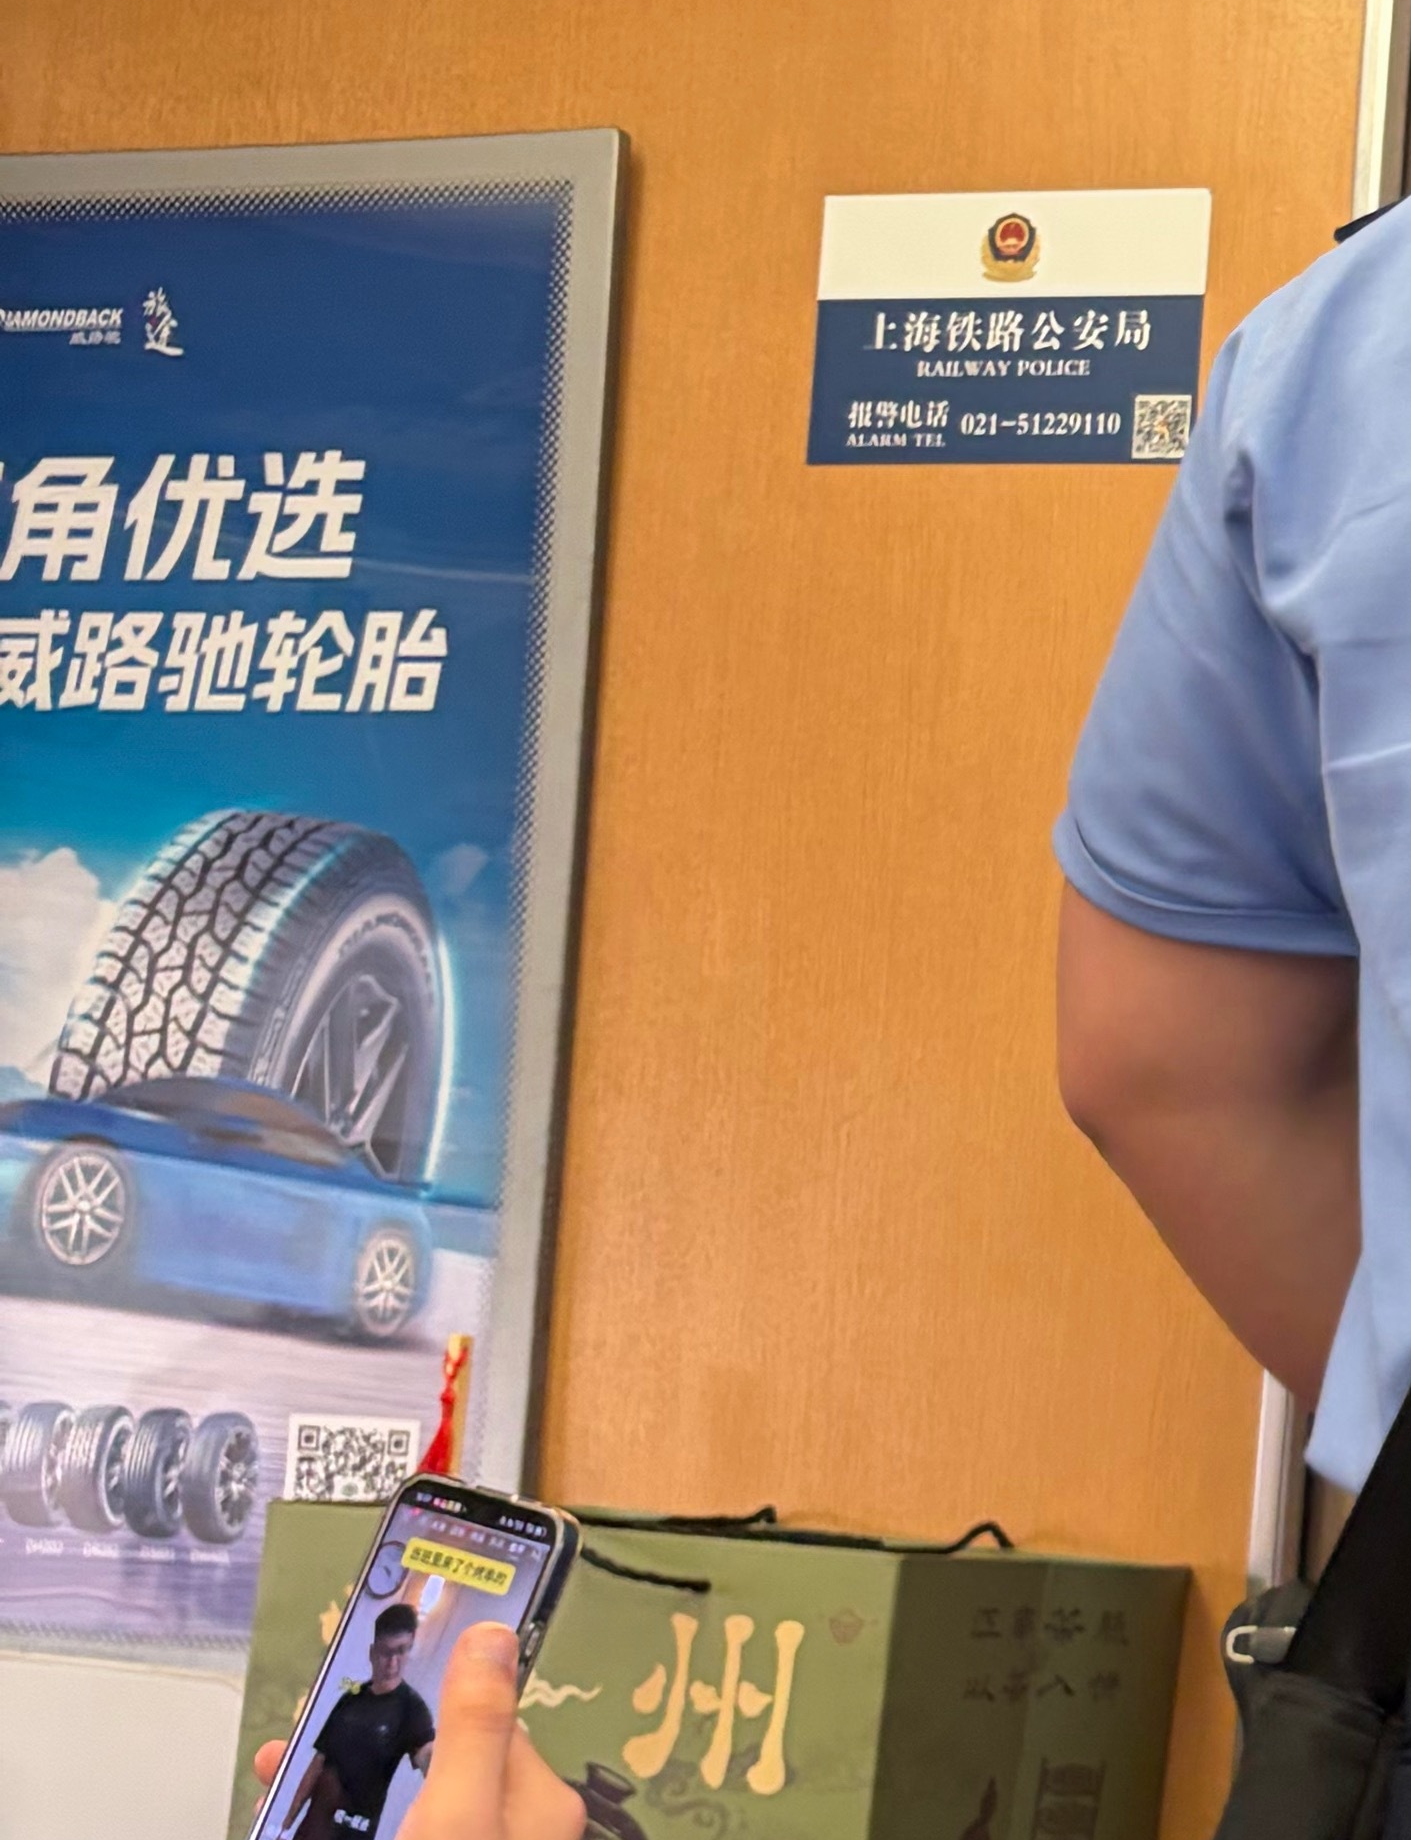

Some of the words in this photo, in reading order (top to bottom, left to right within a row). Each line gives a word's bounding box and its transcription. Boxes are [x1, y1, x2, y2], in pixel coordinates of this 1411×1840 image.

[863, 310, 1151, 353] 上海铁路公安局
[917, 360, 1011, 377] RAILWAY
[1018, 360, 1091, 377] POLICE
[848, 400, 949, 429] 报警电话
[961, 412, 1122, 436] 021-51229110
[846, 434, 907, 447] ALARM
[915, 433, 946, 447] TEL
[0, 449, 366, 581] 角优选
